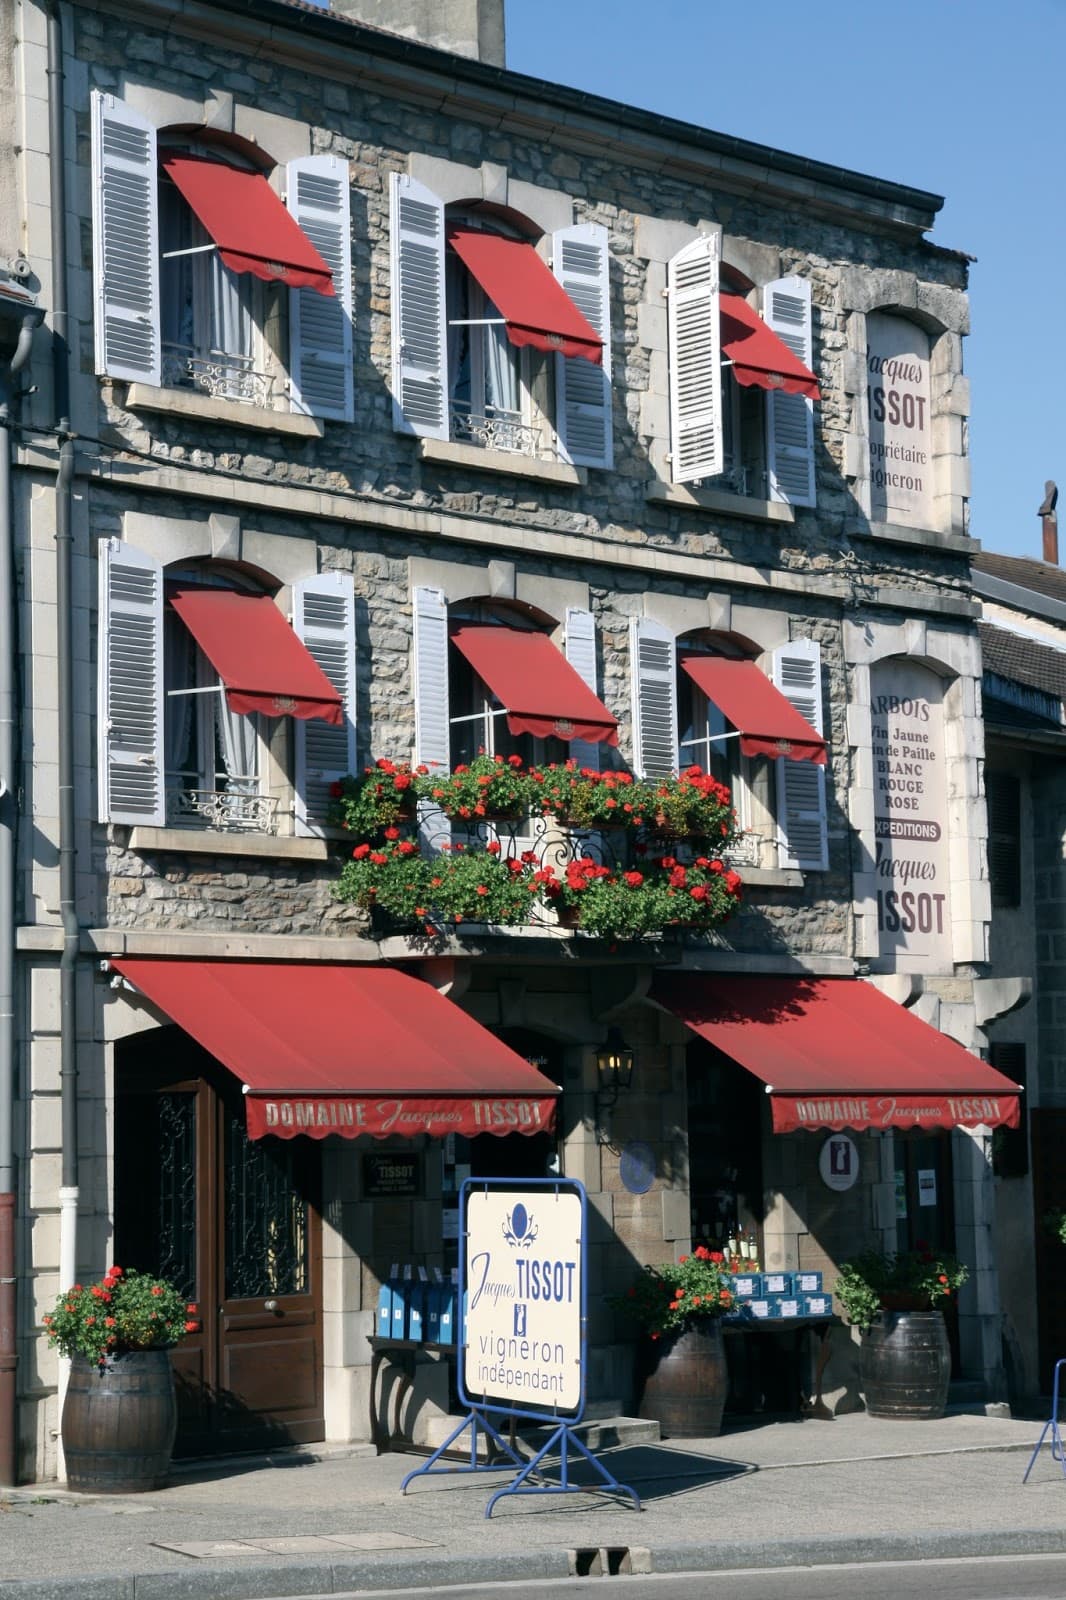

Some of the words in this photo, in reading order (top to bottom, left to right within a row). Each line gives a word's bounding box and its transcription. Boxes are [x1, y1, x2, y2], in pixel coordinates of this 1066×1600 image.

[867, 344, 923, 385] acques
[867, 385, 926, 431] ISSOT
[870, 440, 927, 465] opriétaire
[870, 463, 923, 492] igneron
[893, 727, 929, 744] Jaune
[886, 744, 899, 757] de
[902, 745, 936, 761] Paille
[877, 759, 923, 777] BLANC
[879, 777, 924, 794] ROUGE
[875, 820, 937, 839] XPEDITIONS
[877, 889, 946, 934] ISSOT
[265, 1102, 367, 1127] DOMAINE
[376, 1100, 463, 1130] Jacques
[472, 1100, 542, 1126] TISSOT
[795, 1100, 871, 1122] DOMAINE
[877, 1098, 942, 1124] Jacques
[948, 1099, 1001, 1120] TISSOT
[378, 1165, 415, 1178] TISSOT
[471, 1251, 516, 1311] Jacques
[515, 1259, 576, 1303] TISSOT
[479, 1330, 565, 1365] vigneron
[478, 1361, 564, 1393] indépendant
